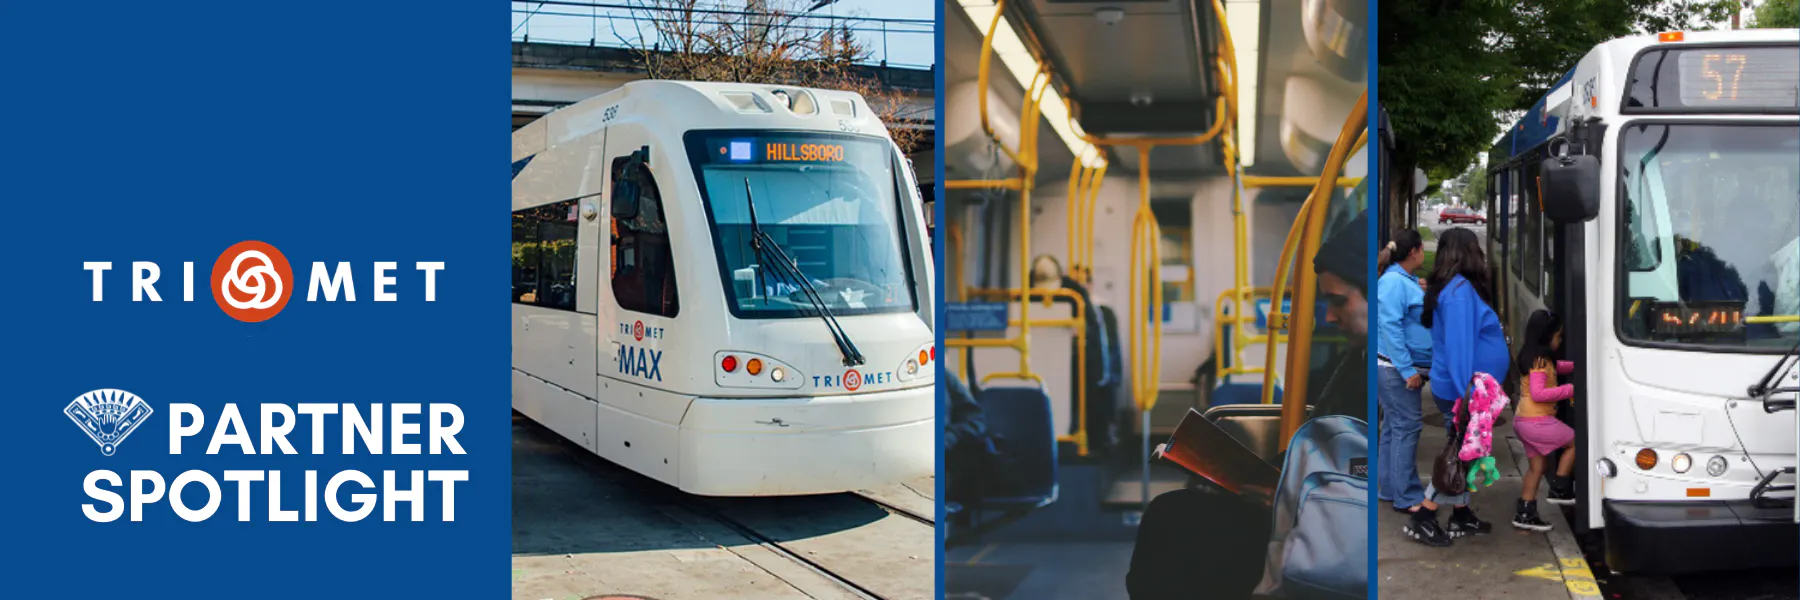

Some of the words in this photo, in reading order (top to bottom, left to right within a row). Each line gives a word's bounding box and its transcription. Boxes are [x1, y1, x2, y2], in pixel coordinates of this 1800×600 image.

[1703, 54, 1746, 100] 57
[766, 143, 844, 162] HILLSBORO
[620, 323, 633, 335] TRI
[645, 326, 664, 339] MET
[619, 344, 663, 382] MAX
[812, 375, 840, 388] TRI
[864, 371, 892, 385] MET
